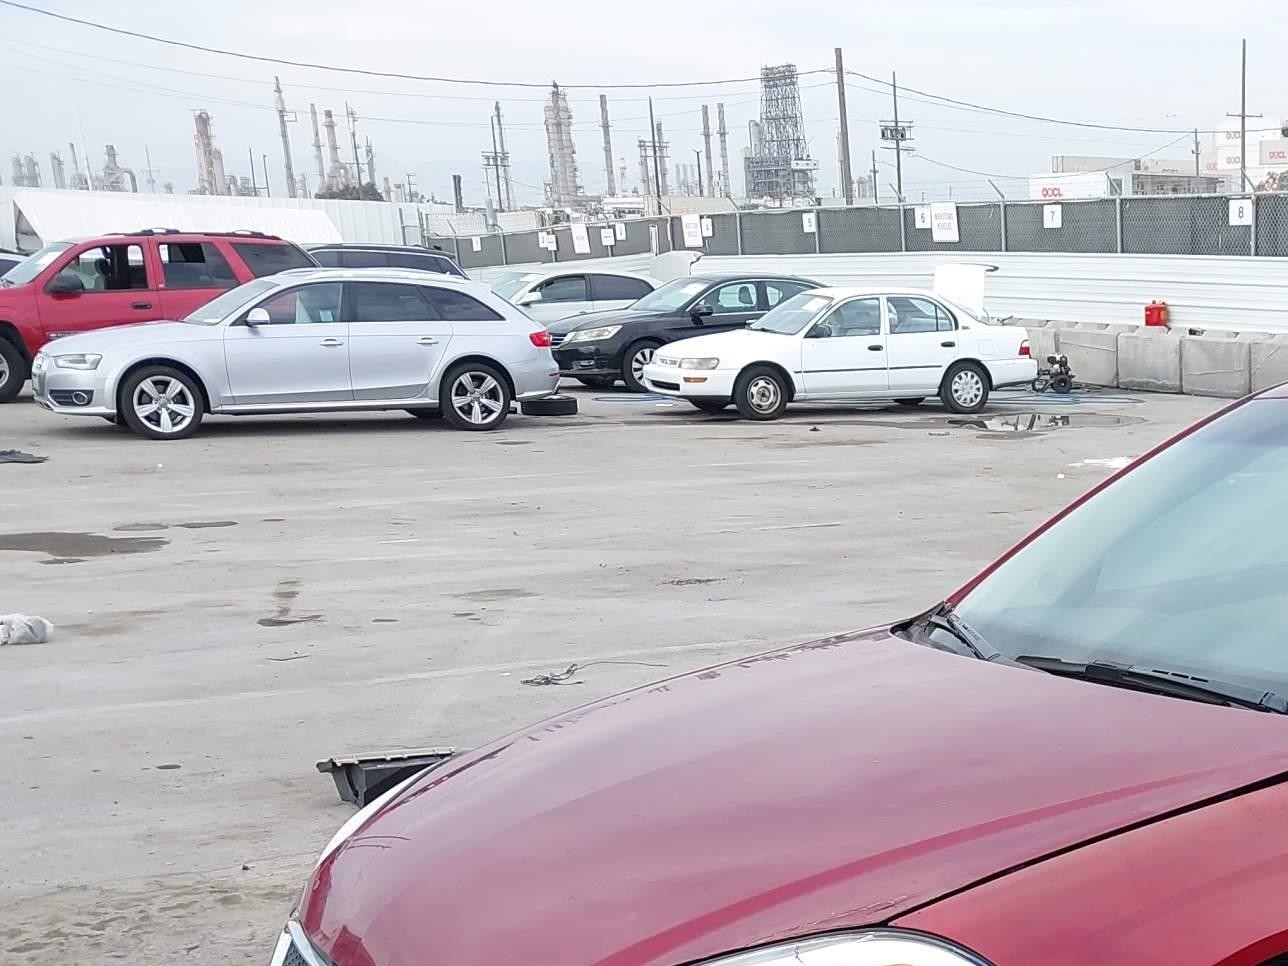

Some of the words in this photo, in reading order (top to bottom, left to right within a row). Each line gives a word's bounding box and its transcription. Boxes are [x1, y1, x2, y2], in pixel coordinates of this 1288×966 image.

[1269, 151, 1287, 160] OOCL
[1041, 187, 1063, 198] OOCL
[920, 212, 926, 224] 6
[1049, 210, 1055, 222] 7
[1238, 205, 1244, 219] 8
